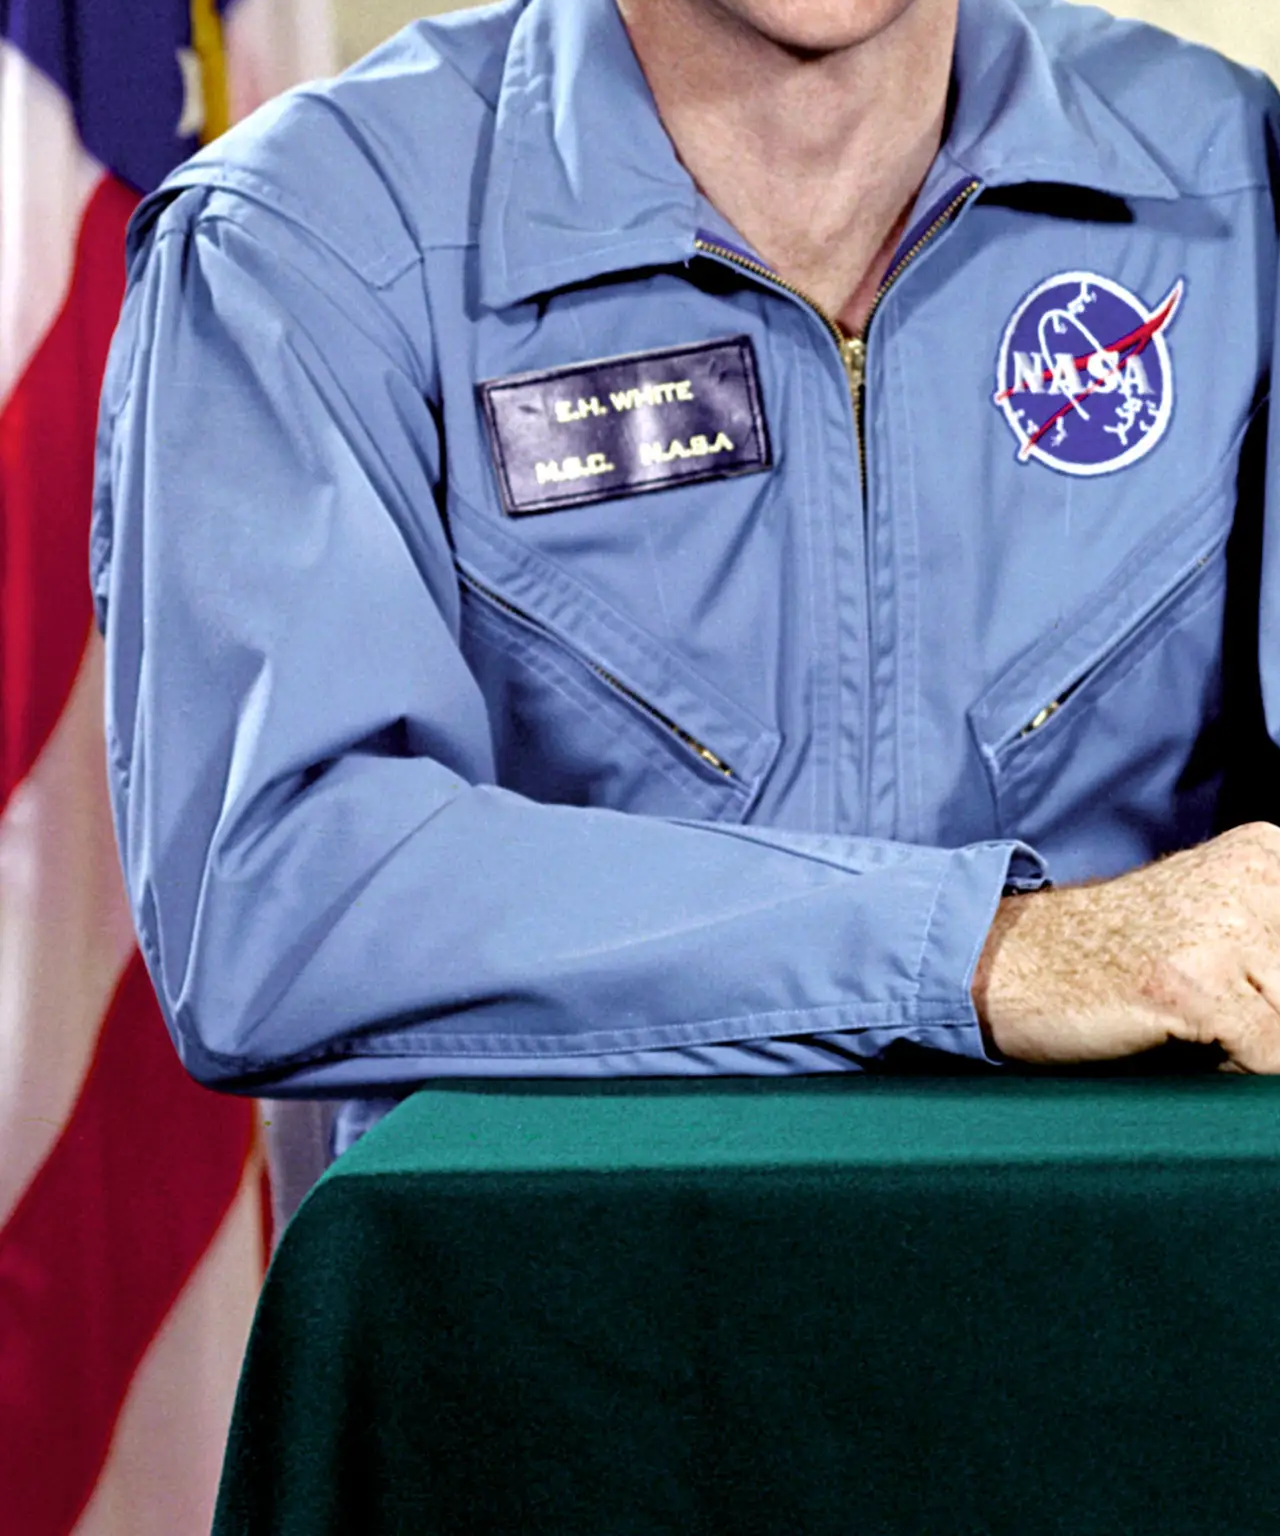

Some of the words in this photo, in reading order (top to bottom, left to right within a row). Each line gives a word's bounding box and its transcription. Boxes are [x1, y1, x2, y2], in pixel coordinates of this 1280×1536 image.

[1012, 351, 1156, 395] NASA
[555, 396, 608, 423] E.H.
[609, 380, 694, 412] WHITE
